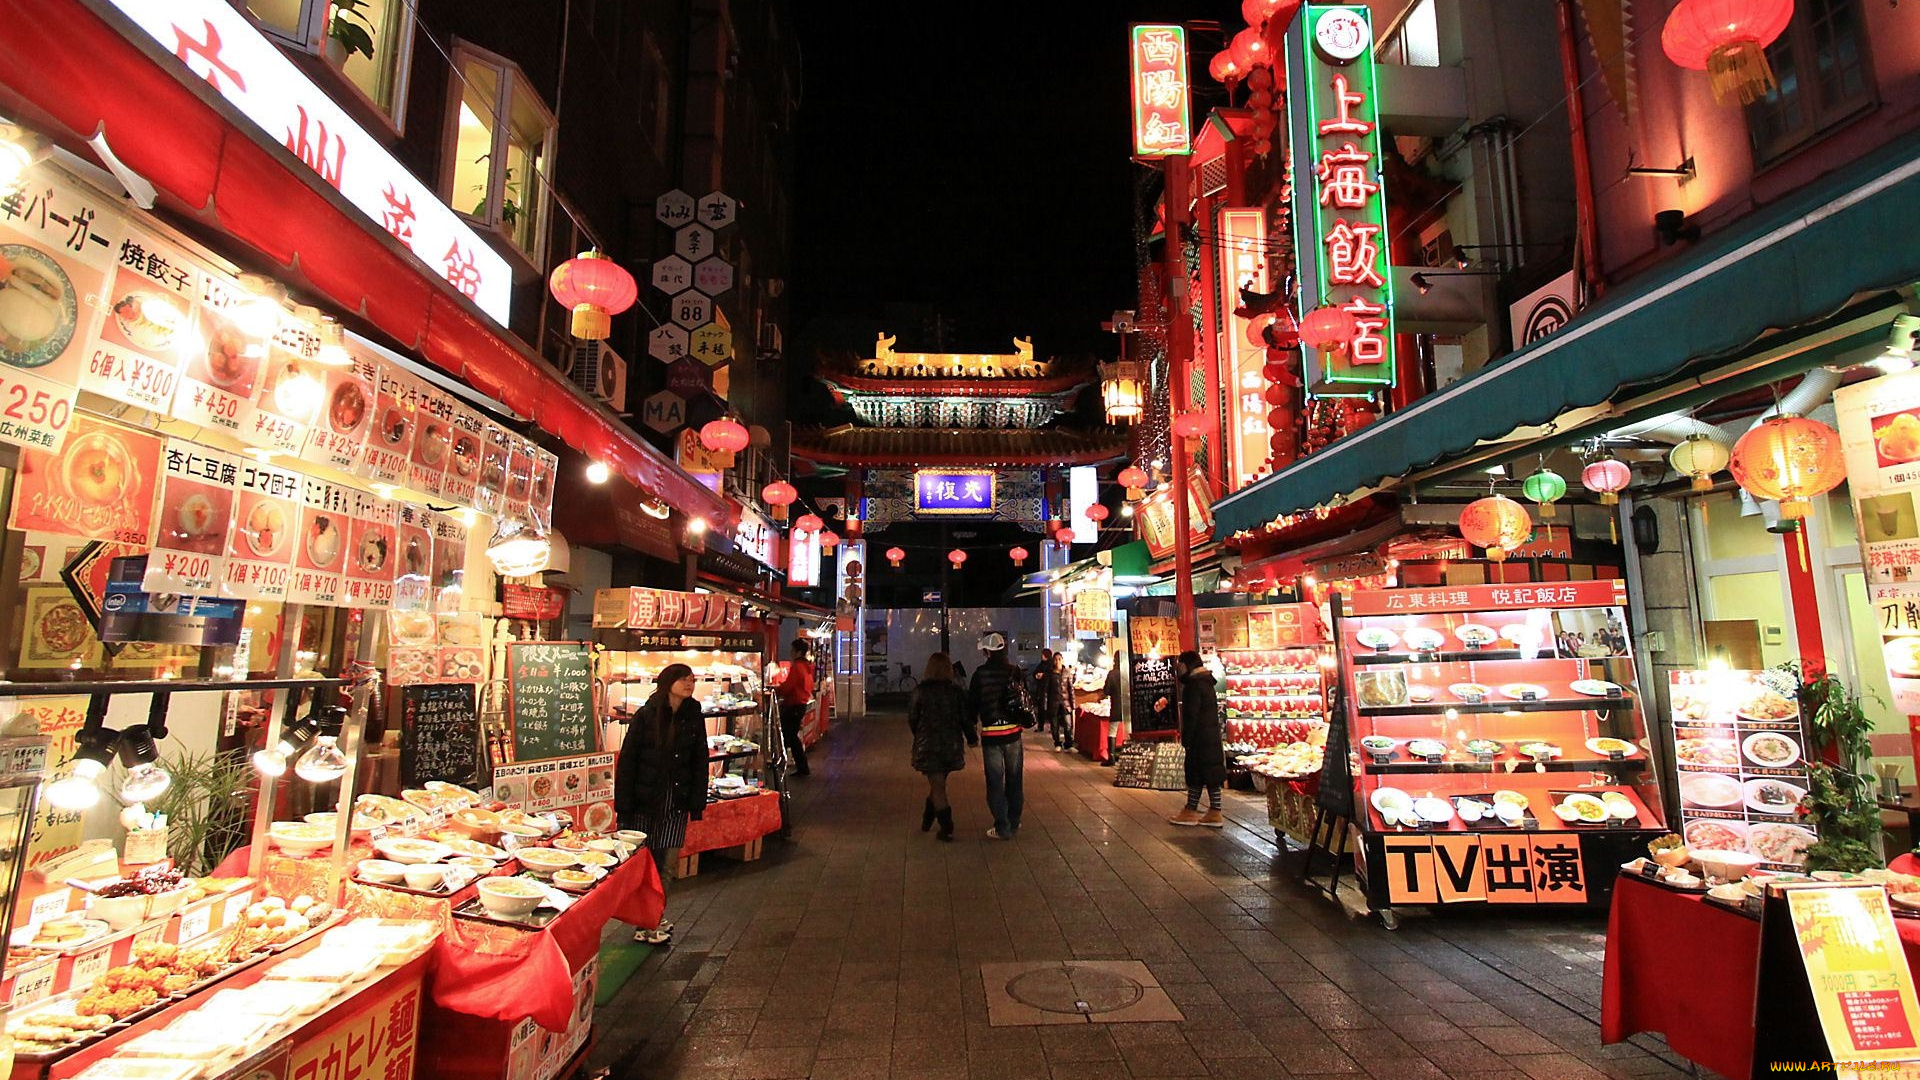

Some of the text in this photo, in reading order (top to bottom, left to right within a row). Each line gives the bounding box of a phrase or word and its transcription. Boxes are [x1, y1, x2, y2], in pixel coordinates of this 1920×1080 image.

[1318, 73, 1388, 365] 上海飯店
[119, 238, 192, 292] 焼餃子
[681, 307, 701, 320] 88
[131, 360, 173, 396] ¥300
[380, 374, 418, 404] ピロシキ
[194, 386, 238, 418] ¥450
[419, 394, 453, 421] エビ餃子
[0, 421, 55, 447] 広州菜館
[255, 414, 294, 441] ¥450
[328, 434, 360, 456] ¥250
[166, 449, 237, 486] 杏仁豆腐
[380, 451, 406, 473] ¥100
[243, 467, 298, 499] ゴマ団子
[457, 480, 475, 499] ¥100
[113, 531, 147, 545] ¥350
[436, 521, 466, 541] 桃まん
[164, 553, 210, 578] ¥200
[1869, 548, 1920, 567] 珍珠奶茶
[251, 564, 287, 586] ¥100
[314, 576, 338, 594] ¥70
[363, 582, 393, 600] ¥150
[1386, 585, 1578, 609] 広東料理 悦記飯店
[1877, 588, 1900, 598] 正宗
[1079, 619, 1110, 631] ¥300
[1387, 843, 1584, 893] TV出演
[1868, 973, 1901, 989] コース
